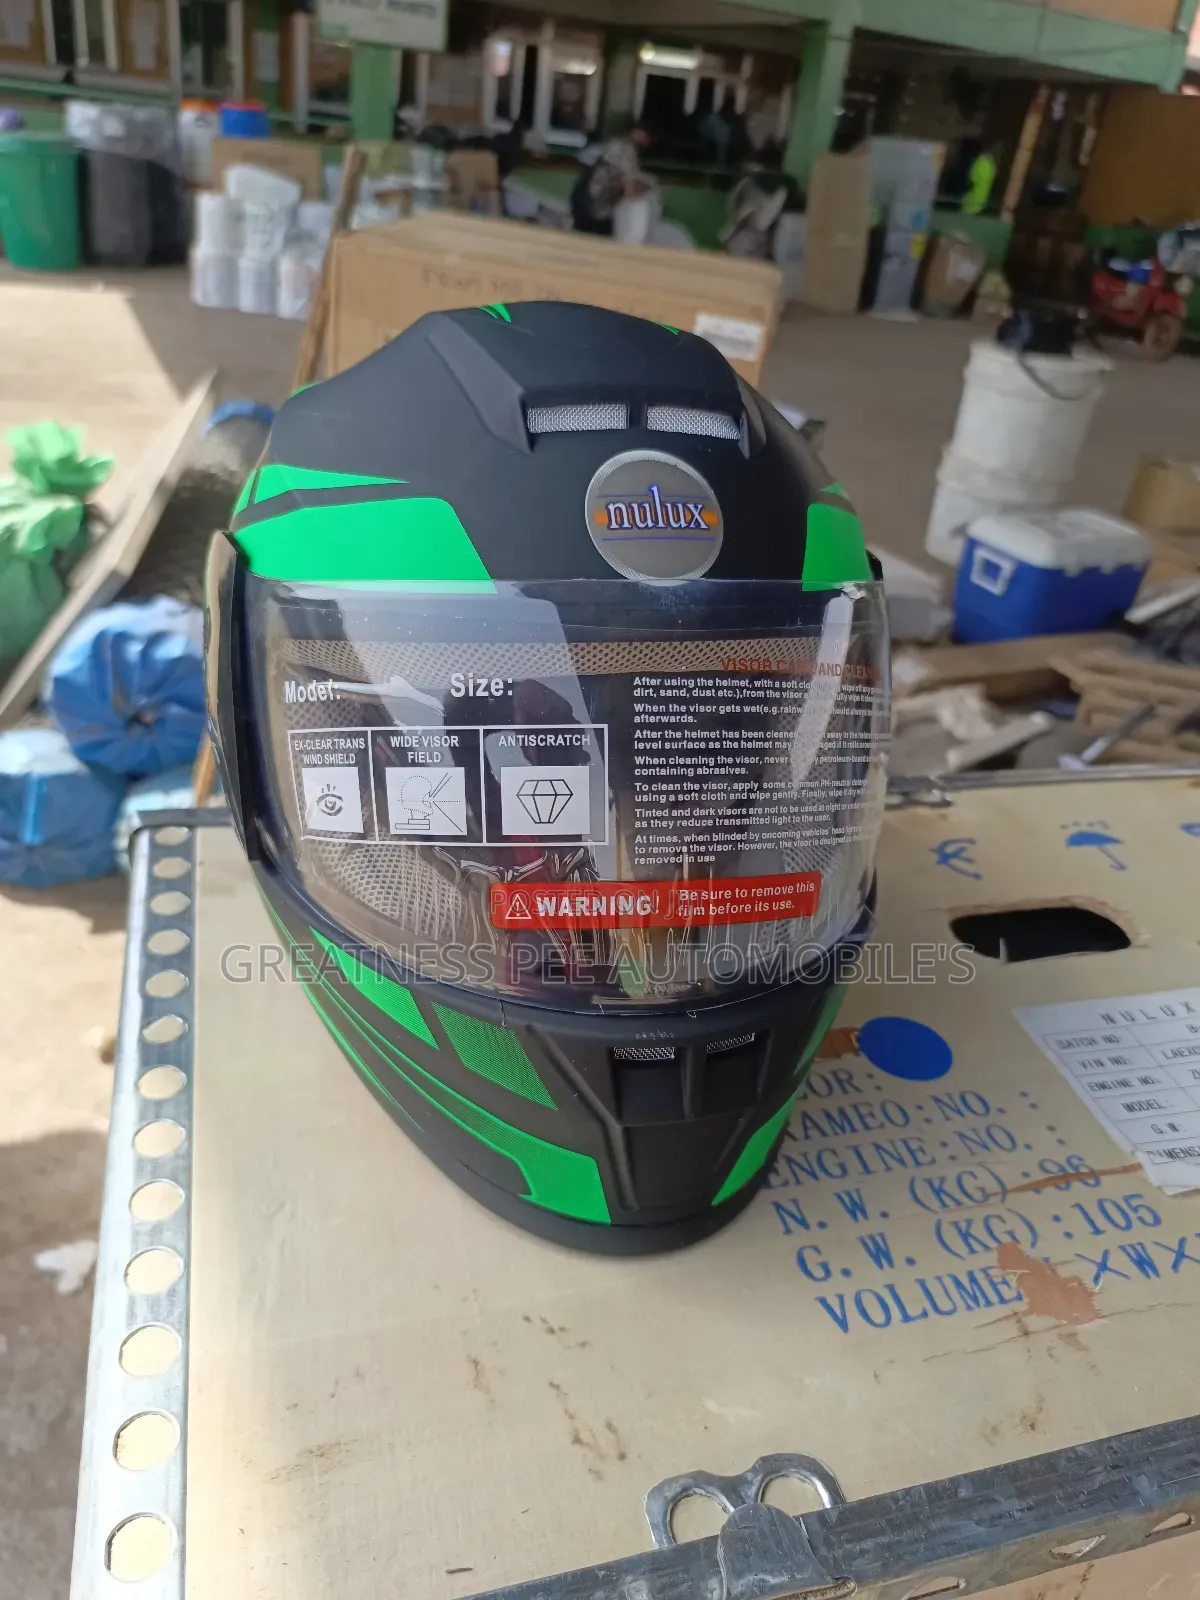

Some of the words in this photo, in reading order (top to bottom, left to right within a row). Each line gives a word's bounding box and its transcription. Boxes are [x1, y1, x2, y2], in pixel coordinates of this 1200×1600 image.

[605, 484, 710, 530] nulux
[720, 657, 772, 673] VISOR
[818, 663, 842, 676] AND
[450, 672, 513, 697] Size:
[633, 677, 661, 686] After
[664, 677, 695, 688] using
[697, 678, 713, 687] the
[716, 678, 752, 688] helmet,
[753, 678, 773, 688] with
[781, 680, 797, 689] soft
[284, 679, 341, 703] Model:
[633, 688, 657, 698] dirt,
[659, 688, 690, 698] sand,
[692, 688, 716, 697] dust
[766, 690, 780, 699] the
[782, 691, 802, 699] visor
[633, 703, 666, 713] When
[669, 703, 687, 713] the
[689, 704, 716, 713] visor
[719, 704, 741, 715] gets
[634, 714, 697, 723] afterwards.
[390, 736, 418, 748] WIDE
[421, 735, 460, 748] VISOR
[498, 734, 591, 747] ANTISCRATCH
[634, 730, 662, 739] After
[664, 730, 682, 739] the
[684, 730, 720, 739] helmet
[722, 730, 740, 738] has
[742, 730, 764, 738] been
[294, 738, 333, 751] EX-CLEAR
[334, 737, 365, 749] TRANS
[634, 740, 661, 749] level
[664, 740, 706, 749] surface
[723, 740, 739, 749] the
[740, 740, 772, 749] helmet
[774, 742, 792, 751] may
[303, 753, 322, 765] WIND
[324, 753, 356, 765] SHIELD
[407, 751, 441, 763] FIELD
[634, 756, 666, 765] When
[668, 756, 715, 766] cleaning
[717, 756, 733, 764] the
[735, 755, 762, 765] visor,
[764, 756, 789, 764] never
[634, 767, 695, 777] containing
[696, 766, 749, 775] abrasives.
[634, 782, 649, 791] To
[652, 782, 681, 791] clean
[683, 782, 700, 791] the
[702, 781, 731, 791] visor,
[733, 781, 759, 791] apply
[763, 781, 786, 789] some
[634, 793, 666, 803] using
[678, 792, 699, 801] soft
[701, 792, 727, 801] cloth
[729, 792, 747, 800] and
[749, 791, 770, 800] wipe
[772, 790, 800, 801] gently.
[801, 789, 828, 799] Finally,
[634, 808, 669, 818] Tinted
[671, 808, 691, 817] and
[693, 807, 716, 816] dark
[718, 807, 747, 816] visors
[765, 806, 778, 814] not
[780, 805, 788, 813] to
[789, 805, 799, 813] be
[800, 804, 817, 812] used
[634, 820, 648, 828] as
[650, 819, 675, 829] they
[676, 818, 714, 827] reduce
[715, 816, 770, 826] transmitted
[772, 815, 791, 825] light
[792, 815, 800, 823] to
[814, 814, 831, 822] user.
[634, 835, 647, 844] At
[649, 834, 681, 844] times,
[683, 833, 710, 843] when
[712, 832, 747, 841] blinded
[749, 832, 760, 841] by
[762, 830, 800, 839] oncoming
[634, 846, 646, 854] to
[648, 845, 687, 854] remove
[690, 844, 706, 853] the
[708, 843, 736, 852] visor.
[737, 841, 778, 852] However,
[780, 840, 791, 848] the
[793, 839, 811, 848] visor
[634, 855, 682, 865] removed
[685, 855, 695, 863] in
[697, 855, 716, 863] use
[679, 889, 698, 901] Be
[701, 887, 732, 901] sure
[735, 887, 748, 898] to
[751, 883, 795, 897] remove
[796, 881, 815, 893] this
[536, 895, 660, 917] WARNING!
[677, 903, 705, 916] film
[709, 901, 751, 916] before
[755, 899, 770, 912] its
[772, 899, 795, 910] use.
[1087, 1078, 1134, 1092] ENGINE
[909, 1162, 1008, 1214] (KG)
[815, 1266, 1023, 1334] VOLUME
